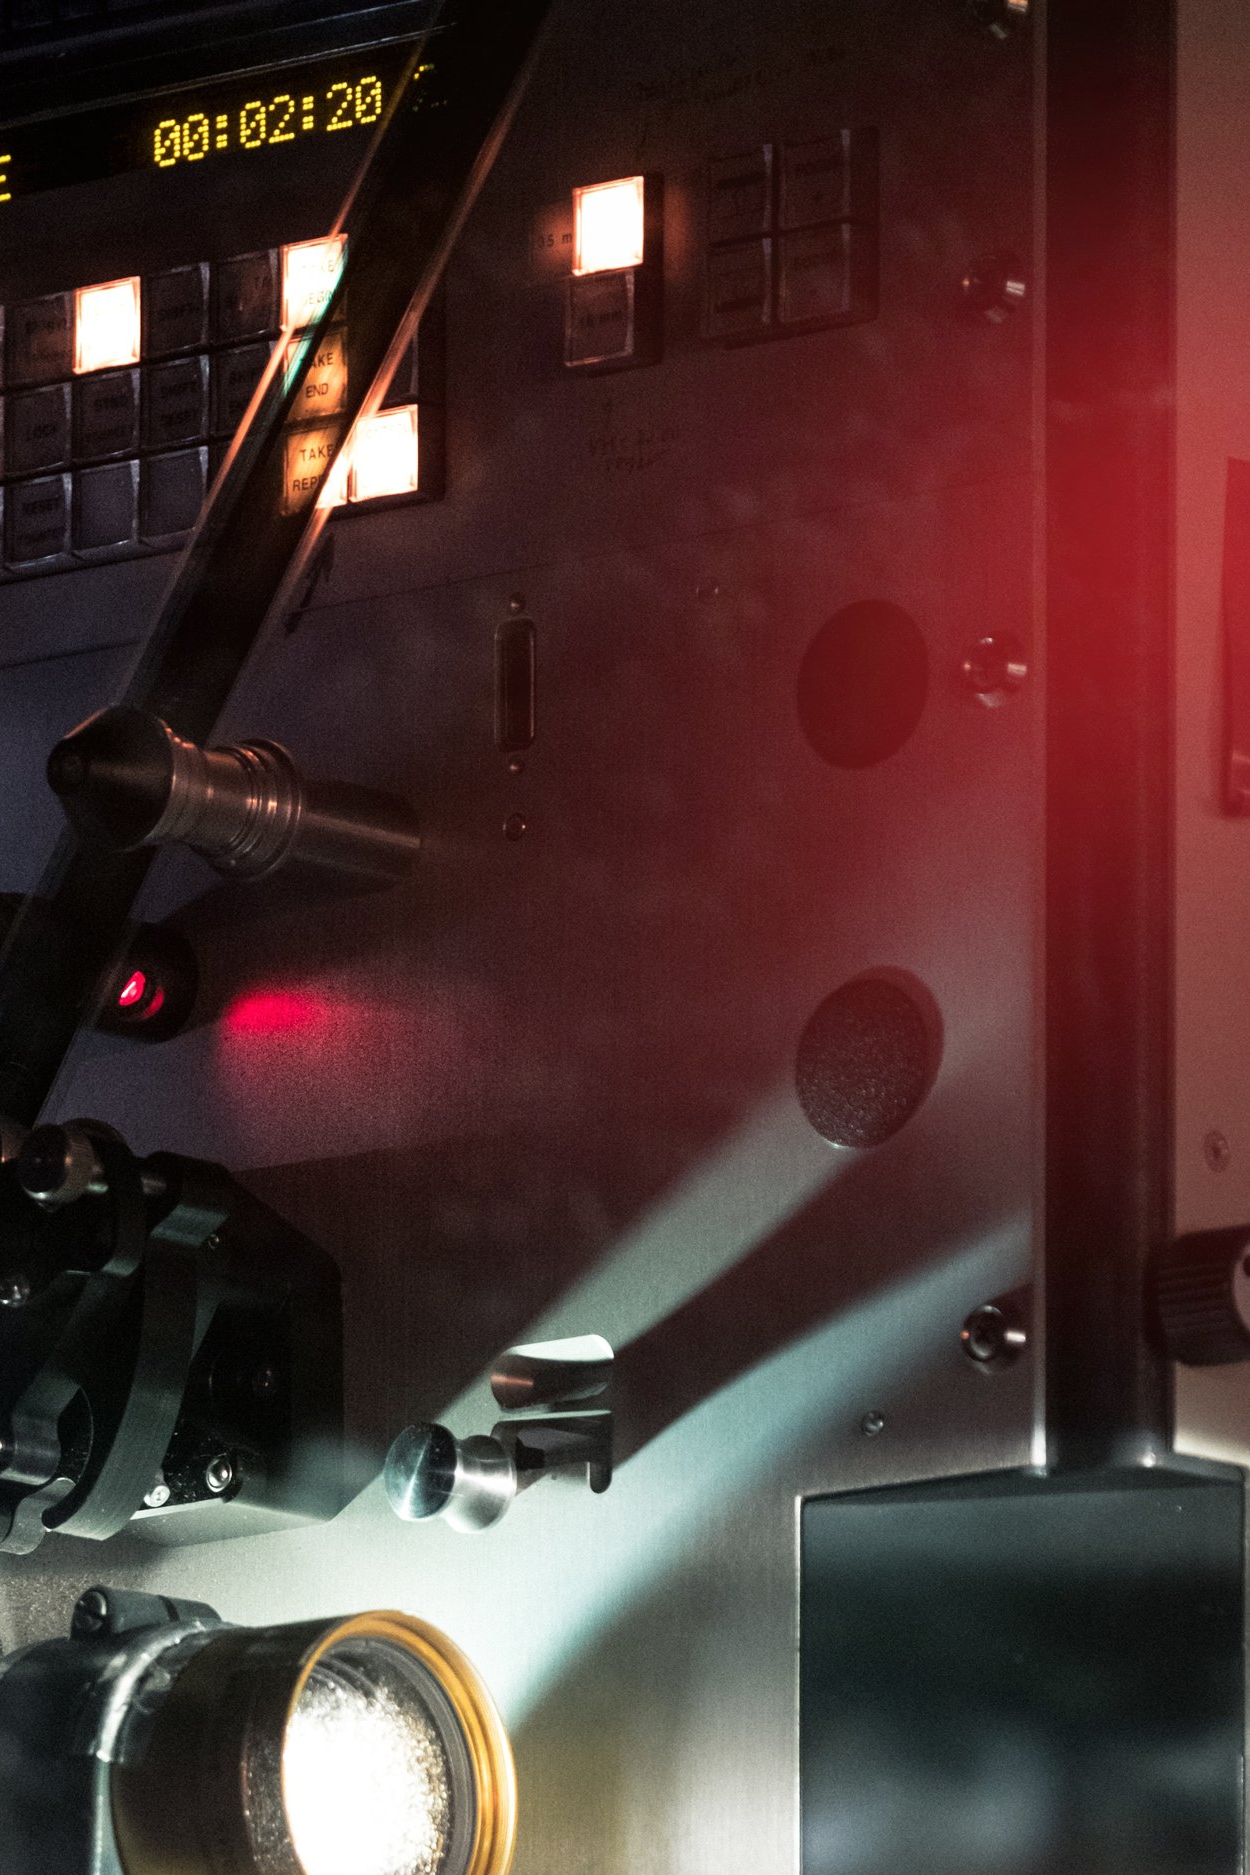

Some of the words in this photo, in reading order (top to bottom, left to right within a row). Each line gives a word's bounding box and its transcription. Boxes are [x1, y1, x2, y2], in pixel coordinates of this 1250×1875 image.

[154, 76, 383, 168] 00:02:20
[305, 383, 329, 398] END
[299, 444, 335, 462] TAKE
